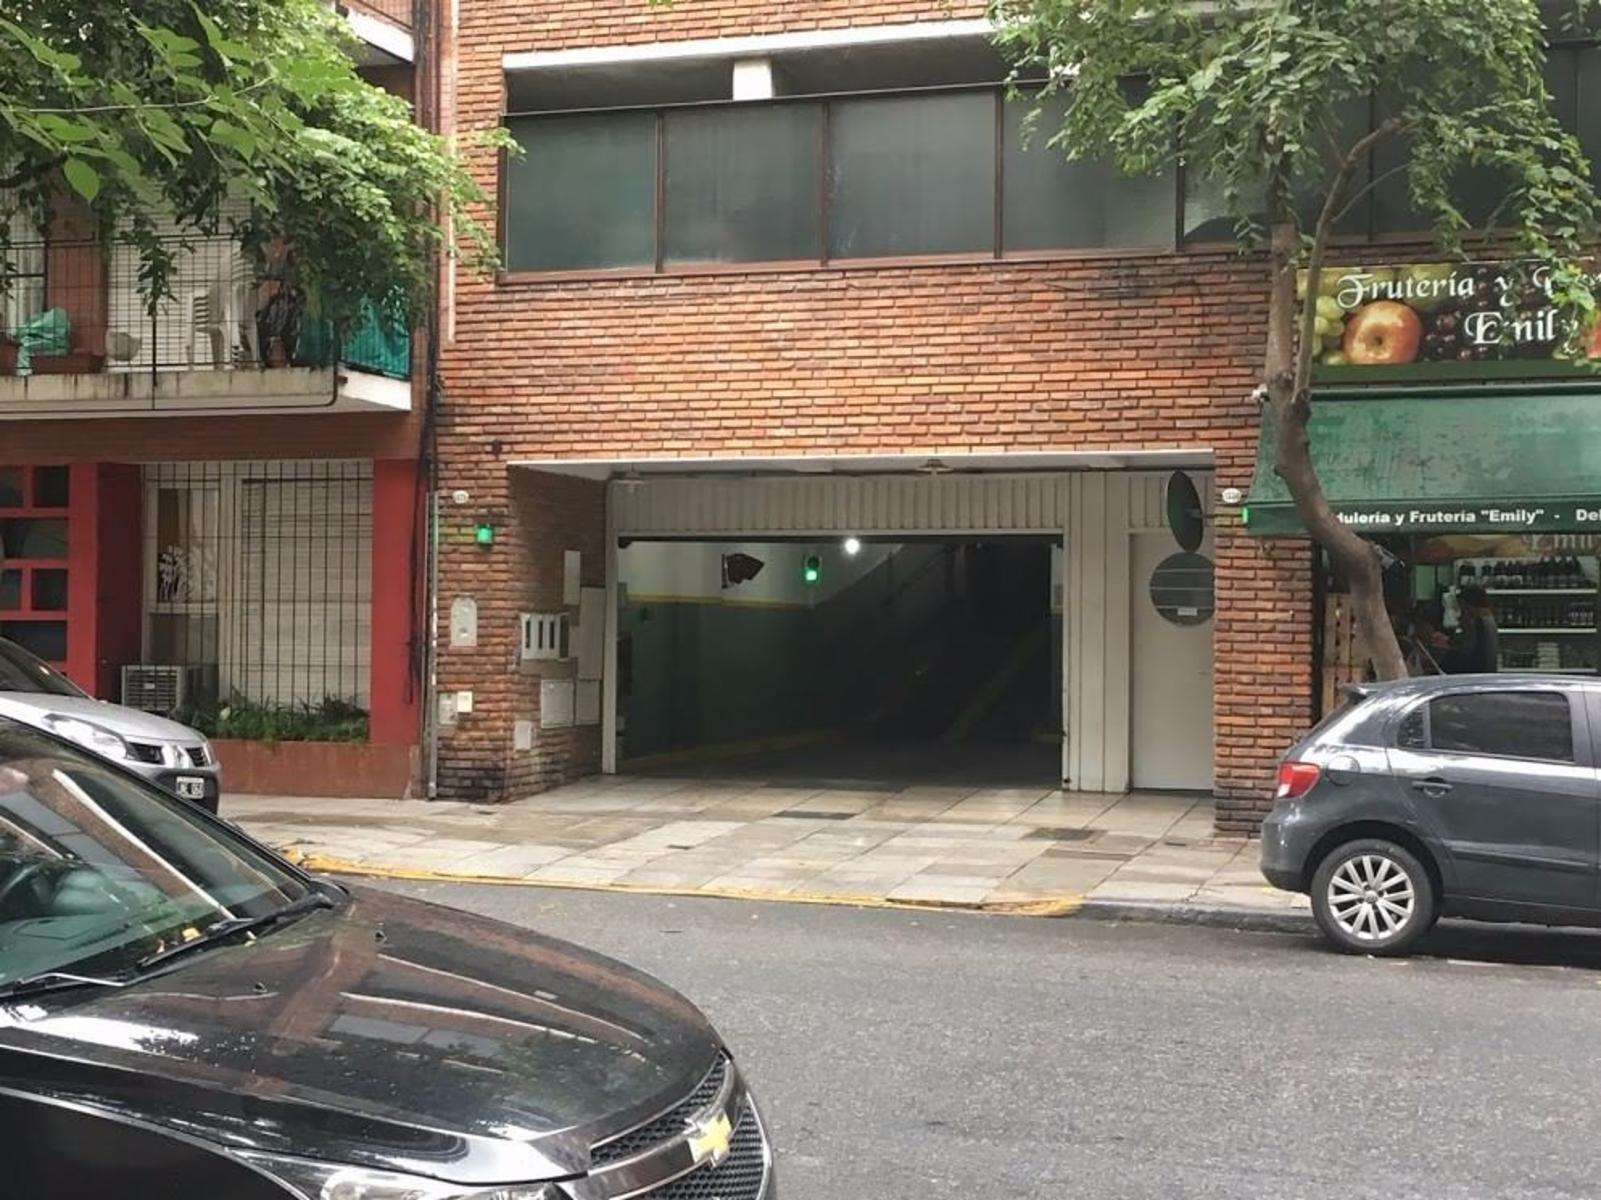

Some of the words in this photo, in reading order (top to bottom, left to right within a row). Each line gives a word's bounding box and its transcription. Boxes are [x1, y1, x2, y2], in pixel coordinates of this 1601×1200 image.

[1336, 270, 1474, 309] Frutería
[1394, 513, 1405, 526] y
[1480, 508, 1544, 525] "Emily"
